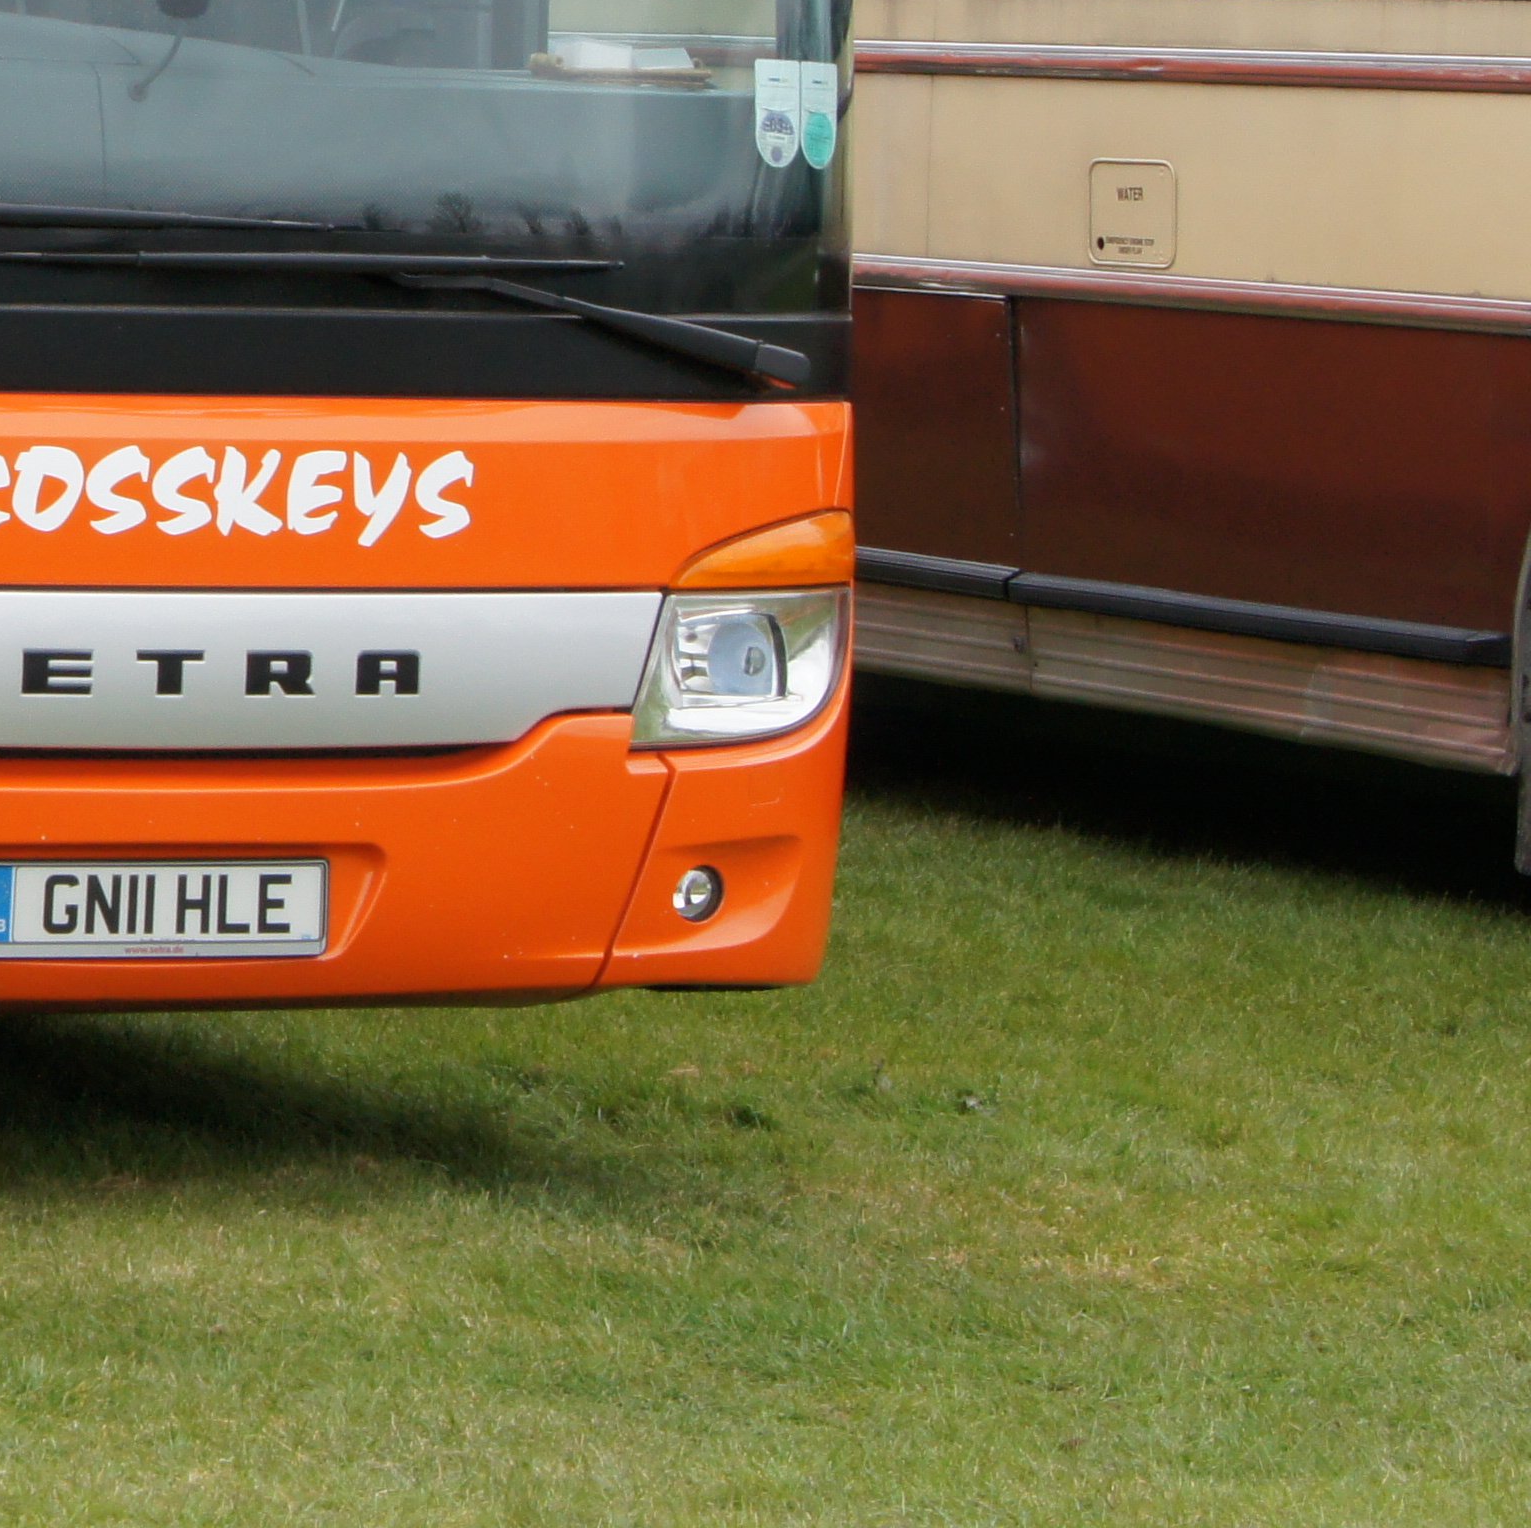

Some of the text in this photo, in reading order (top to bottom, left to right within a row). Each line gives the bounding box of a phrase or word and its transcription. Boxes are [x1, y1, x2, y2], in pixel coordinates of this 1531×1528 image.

[1116, 186, 1144, 201] WATER
[42, 874, 156, 935] GN11
[176, 874, 293, 935] HLE
